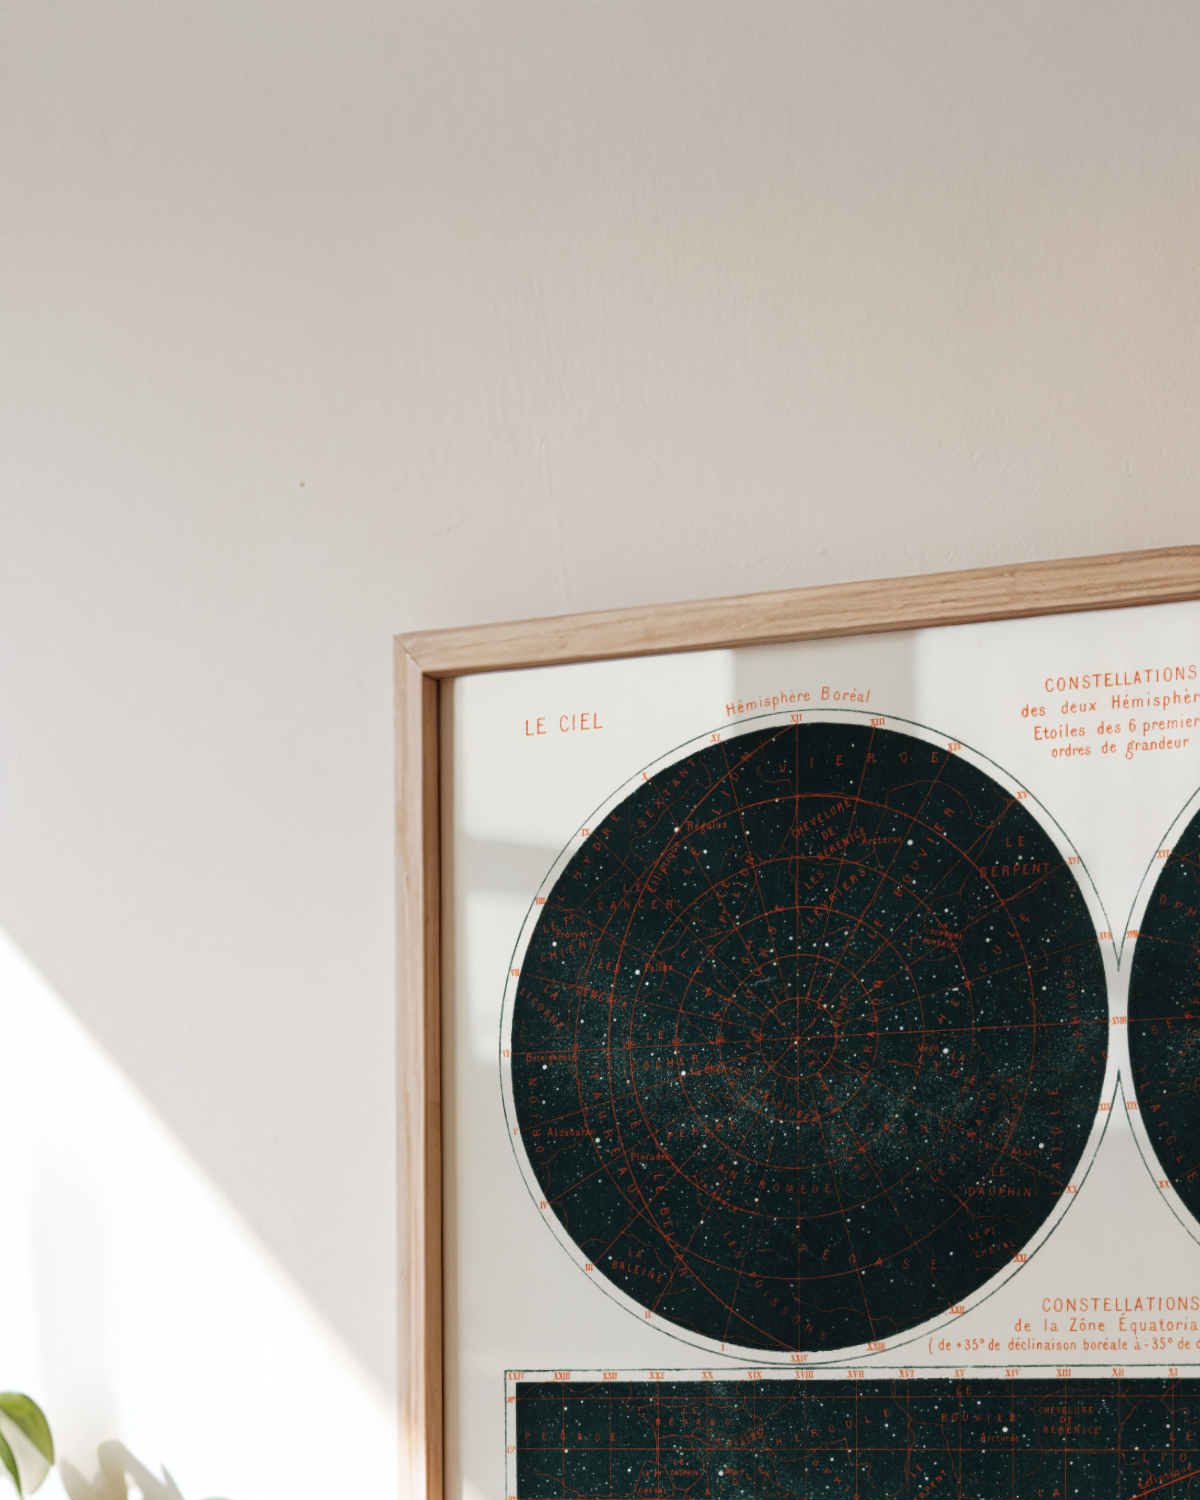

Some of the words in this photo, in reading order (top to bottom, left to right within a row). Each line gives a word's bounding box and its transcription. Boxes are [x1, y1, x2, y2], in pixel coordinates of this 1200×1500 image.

[1045, 665, 1198, 693] CONSTELLATIONS
[725, 689, 811, 717] Hémisphère
[821, 685, 871, 703] Boréal
[1021, 702, 1046, 718] des
[1061, 700, 1097, 714] deux
[525, 717, 547, 736] LE
[559, 712, 604, 733] CIEL
[1034, 722, 1086, 741] Etoiles
[1097, 720, 1122, 735] des
[1128, 718, 1137, 732] 6
[1051, 744, 1092, 758] ordres
[1101, 740, 1117, 754] de
[1125, 735, 1190, 760] grandeur
[638, 757, 696, 828] SEXTANT
[792, 798, 852, 838] CHEVELURE
[821, 827, 836, 841] DE
[1006, 835, 1026, 848] LE
[979, 862, 1050, 878] SERPENT
[804, 869, 825, 890] LES
[622, 883, 643, 893] LE
[597, 899, 673, 910] CANCER
[555, 929, 590, 941] Procyon
[540, 940, 588, 961] CHIEN
[597, 959, 621, 973] LES
[543, 984, 559, 1001] LA
[519, 986, 565, 1031] LICORNE
[646, 1030, 665, 1041] LE
[632, 1055, 699, 1071] COCHER
[991, 1167, 1006, 1177] LE
[968, 1187, 1031, 1197] DAUPHIN
[628, 1247, 642, 1259] LA
[611, 1260, 664, 1284] BALEINE
[1042, 1296, 1200, 1313] CONSTELLATIONS
[1014, 1318, 1031, 1332] de
[1044, 1318, 1059, 1332] la
[1069, 1317, 1106, 1332] Zône
[987, 1338, 1001, 1351] de
[1007, 1337, 1077, 1351] déclinaison
[1083, 1337, 1128, 1351] boréale
[1134, 1337, 1141, 1350] à
[1177, 1337, 1191, 1350] de
[941, 1413, 1016, 1422] BOUVIER
[1039, 1406, 1094, 1415] CHEVELURE
[670, 1469, 699, 1477] DAUPHIN
